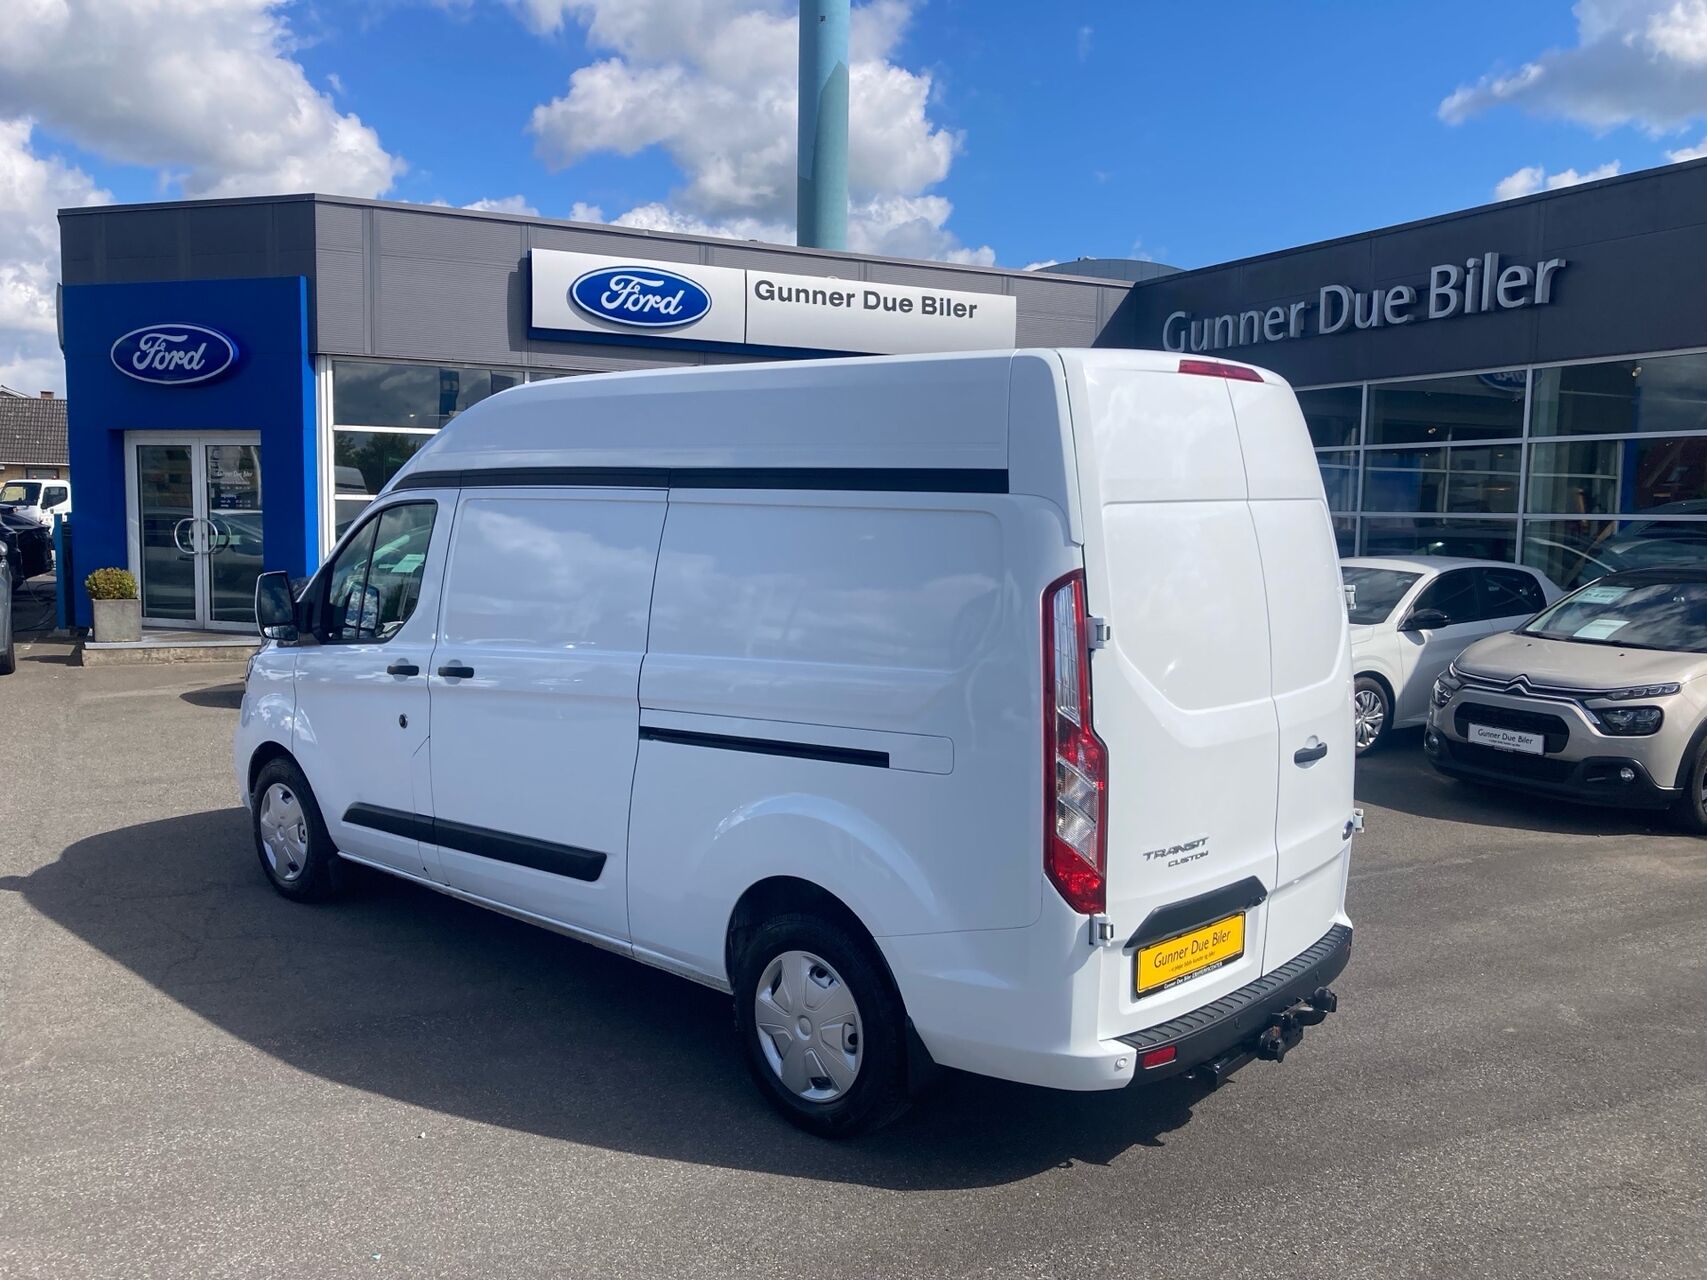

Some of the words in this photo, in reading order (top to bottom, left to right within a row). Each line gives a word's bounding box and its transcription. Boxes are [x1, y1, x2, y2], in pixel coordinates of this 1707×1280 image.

[600, 274, 685, 316] Ford
[754, 279, 856, 308] Gunner
[863, 289, 914, 313] Due
[921, 295, 978, 319] Biler
[1162, 299, 1310, 352] Gunner
[1318, 284, 1416, 335] Due
[1428, 252, 1566, 319] Biler
[132, 332, 207, 371] Ford
[1477, 728, 1501, 740] Gunner
[1502, 732, 1516, 742] Due
[1518, 735, 1534, 745] Biler
[1142, 836, 1210, 862] TRANSIT
[1153, 946, 1188, 968] Gunner
[1191, 939, 1209, 955] Due
[1212, 930, 1232, 947] Biler
